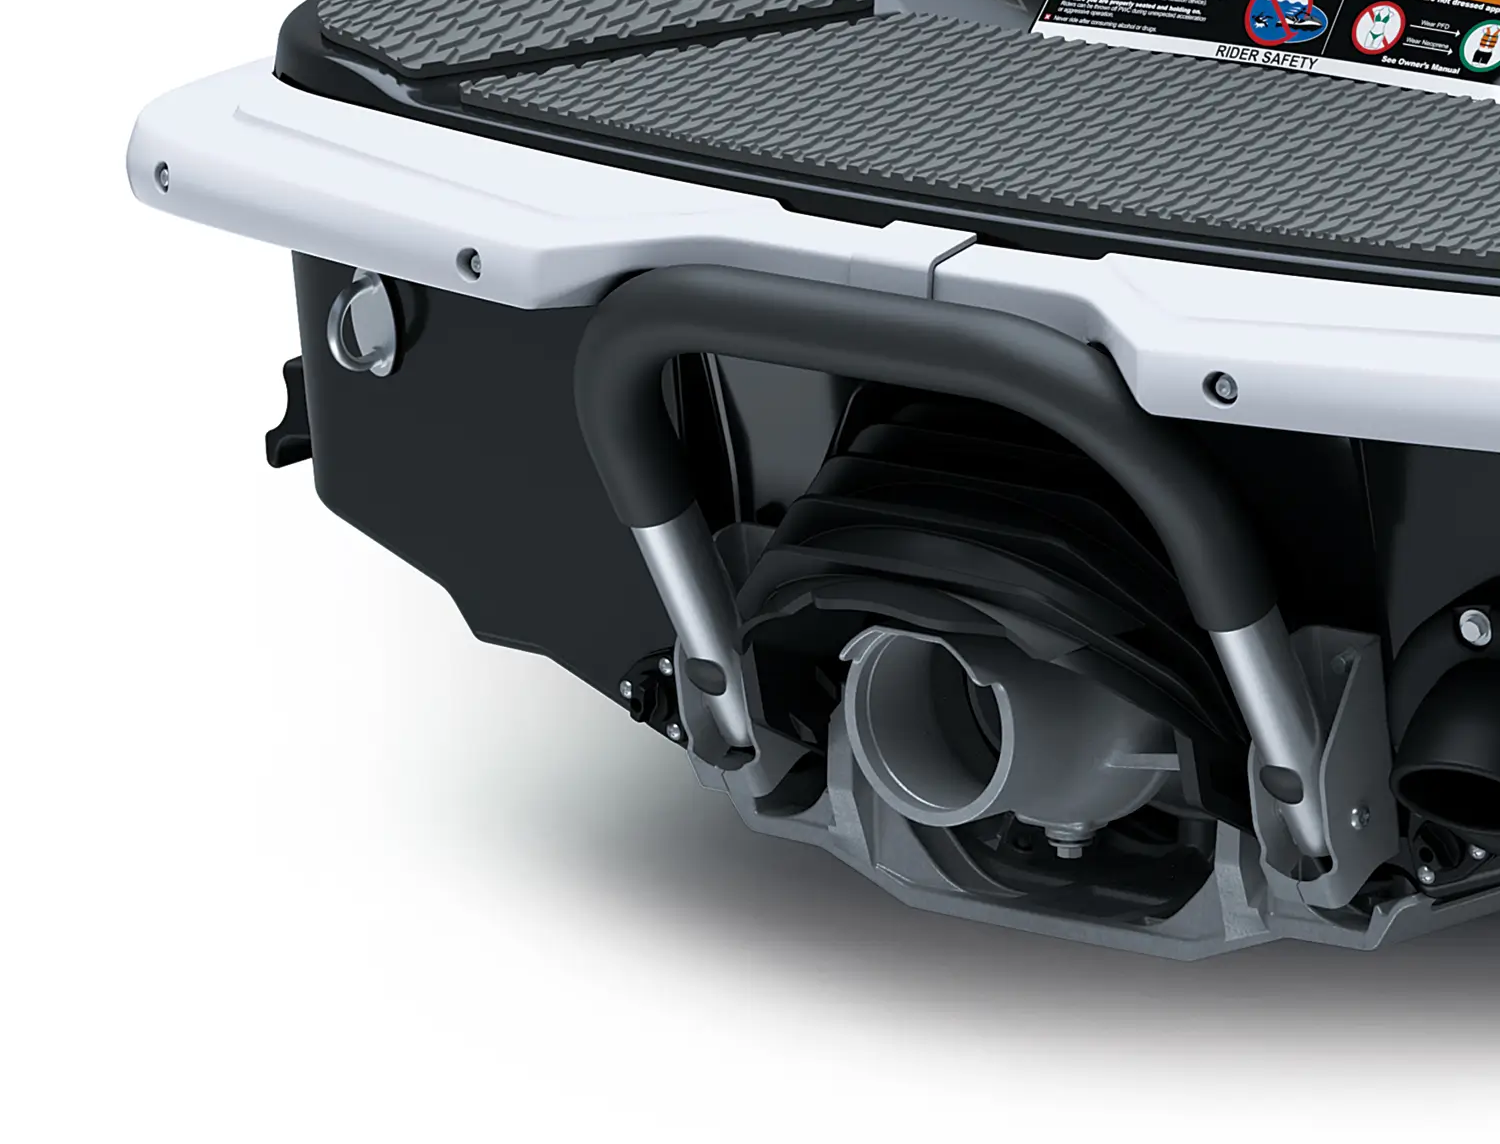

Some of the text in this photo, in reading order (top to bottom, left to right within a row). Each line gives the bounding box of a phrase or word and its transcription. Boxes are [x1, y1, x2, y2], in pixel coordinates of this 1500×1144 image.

[1109, 0, 1134, 9] properly
[1169, 6, 1191, 14] holding
[1090, 20, 1117, 28] consuming
[1422, 39, 1449, 49] Neoprene
[1216, 45, 1318, 70] RIDER SAFETY
[1381, 55, 1461, 74] See Owner's Manual
